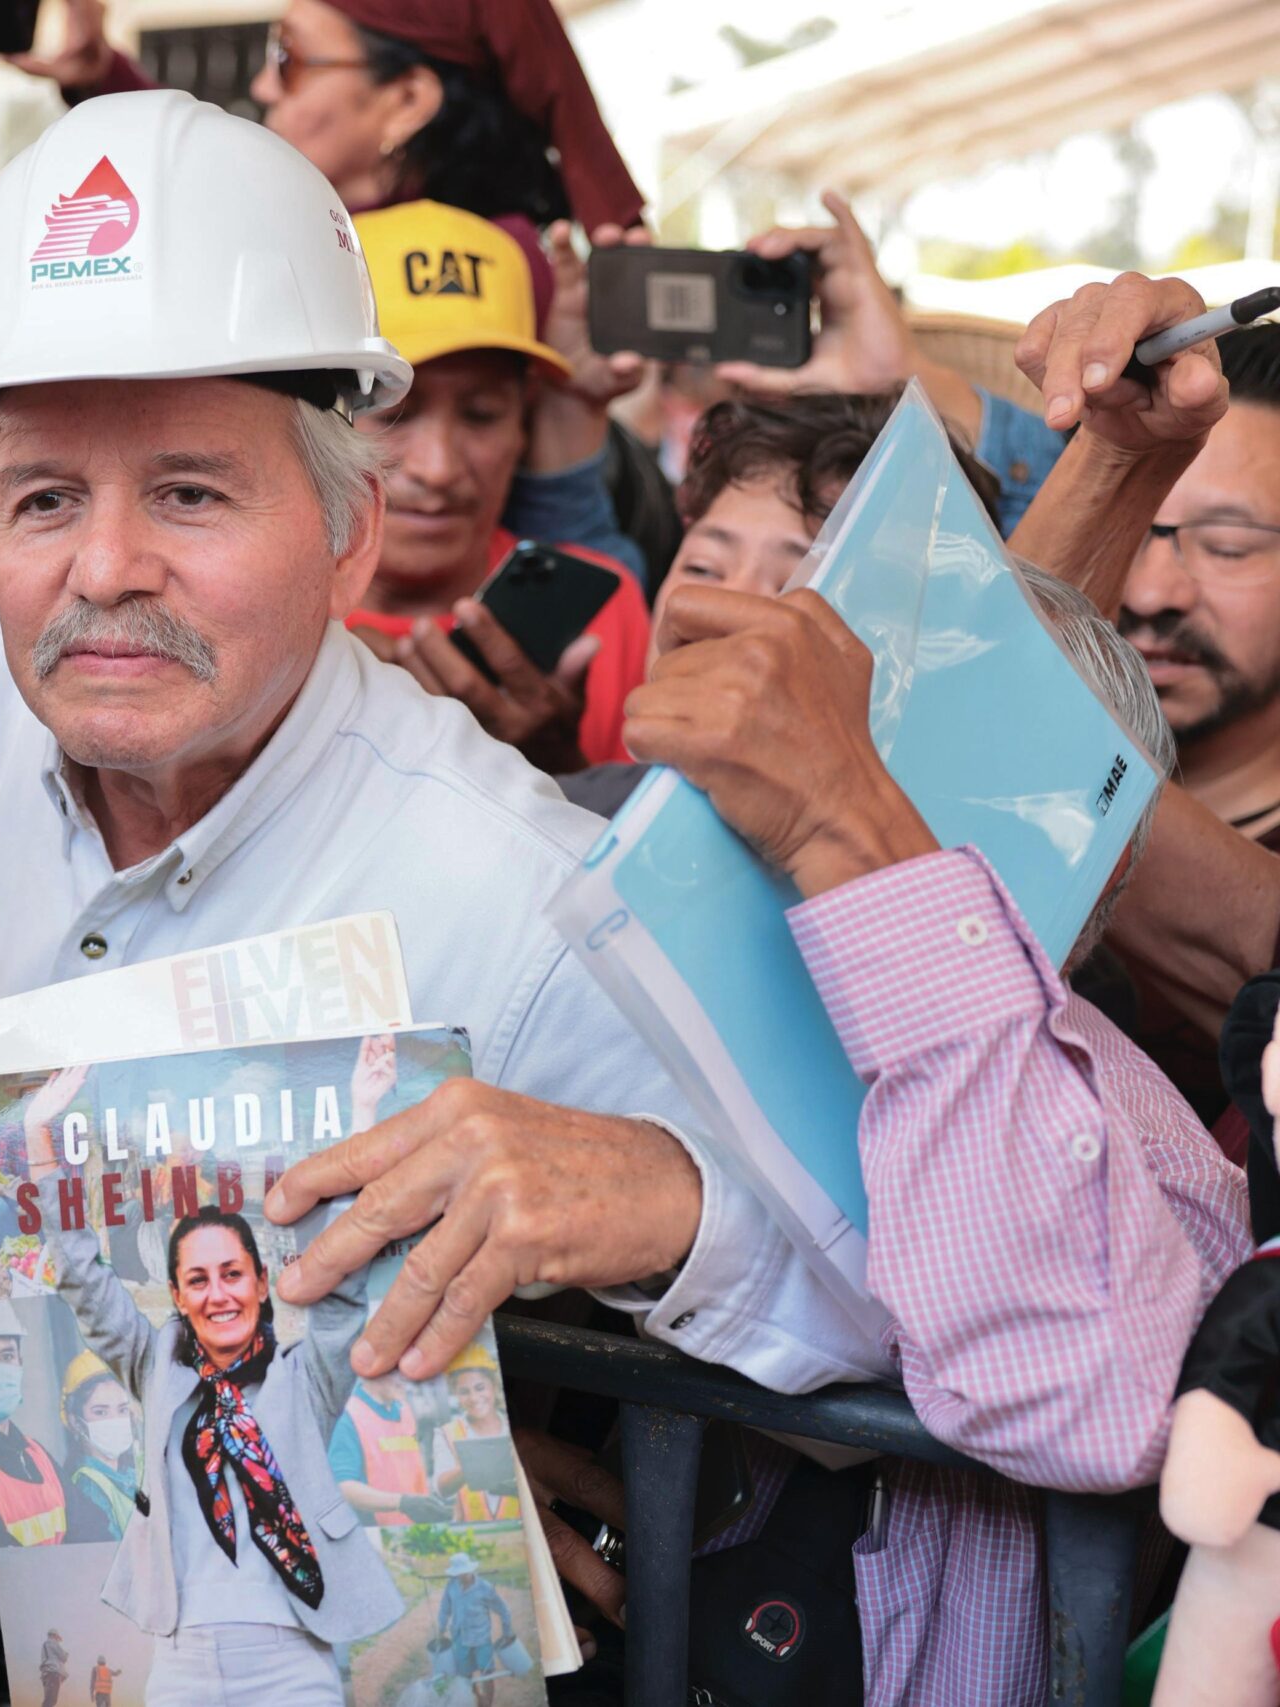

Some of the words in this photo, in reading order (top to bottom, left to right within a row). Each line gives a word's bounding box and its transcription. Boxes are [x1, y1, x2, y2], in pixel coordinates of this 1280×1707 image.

[31, 256, 132, 283] PEMEX
[405, 251, 496, 299] CAT
[1102, 753, 1128, 802] MAE
[170, 917, 392, 1010] FILVEN
[62, 1085, 343, 1166] CLAUDIA
[751, 1631, 777, 1653] SPORT
